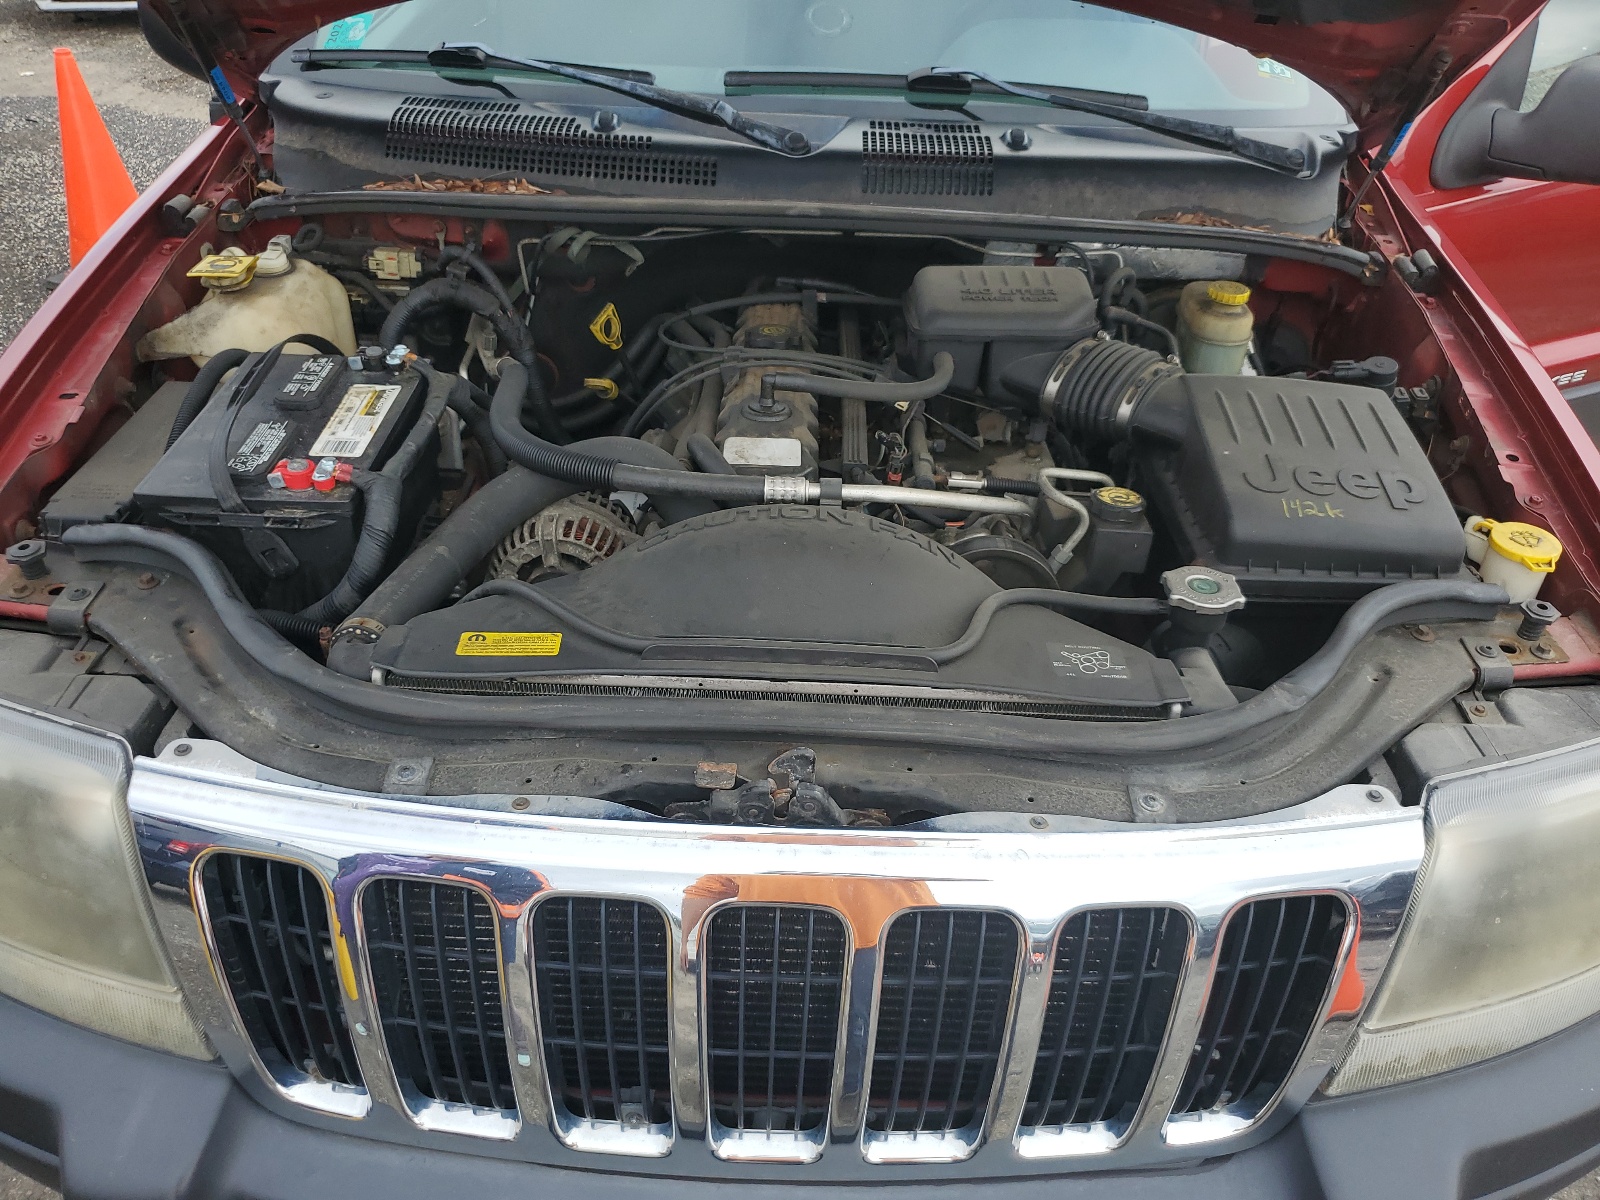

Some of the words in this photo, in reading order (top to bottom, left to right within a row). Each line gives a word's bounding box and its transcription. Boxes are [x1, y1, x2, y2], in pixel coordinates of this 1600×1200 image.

[327, 19, 346, 44] 202
[1242, 453, 1429, 511] Jeep
[636, 504, 853, 552] CAUTION
[869, 518, 962, 569] FAN
